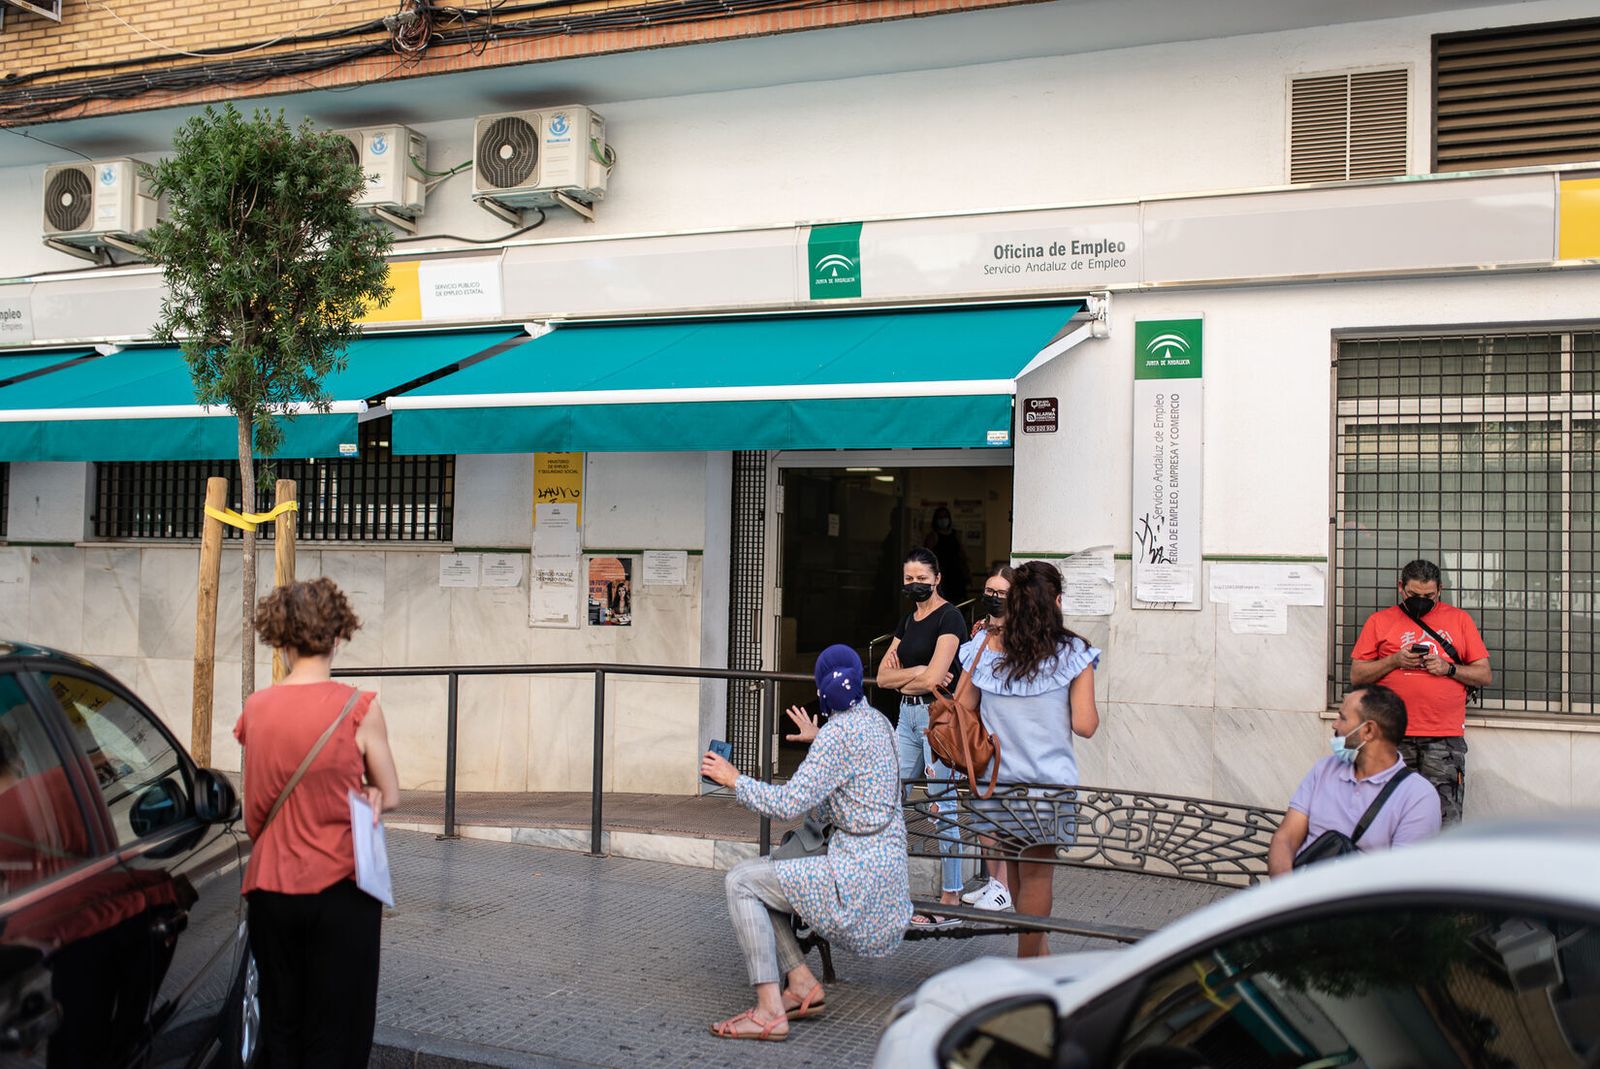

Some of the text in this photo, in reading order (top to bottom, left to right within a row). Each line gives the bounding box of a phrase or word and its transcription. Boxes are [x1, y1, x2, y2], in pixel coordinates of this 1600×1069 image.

[994, 238, 1126, 260] Oficina de Empleo
[984, 258, 1126, 274] Servicio Andaluz de Empleo
[0, 308, 22, 321] mpleo
[1170, 393, 1180, 440] COMERCIO
[1152, 393, 1167, 520] Servicio Andaluz de Empleo
[1169, 448, 1179, 488] EMPRESA
[1168, 528, 1178, 541] DE
